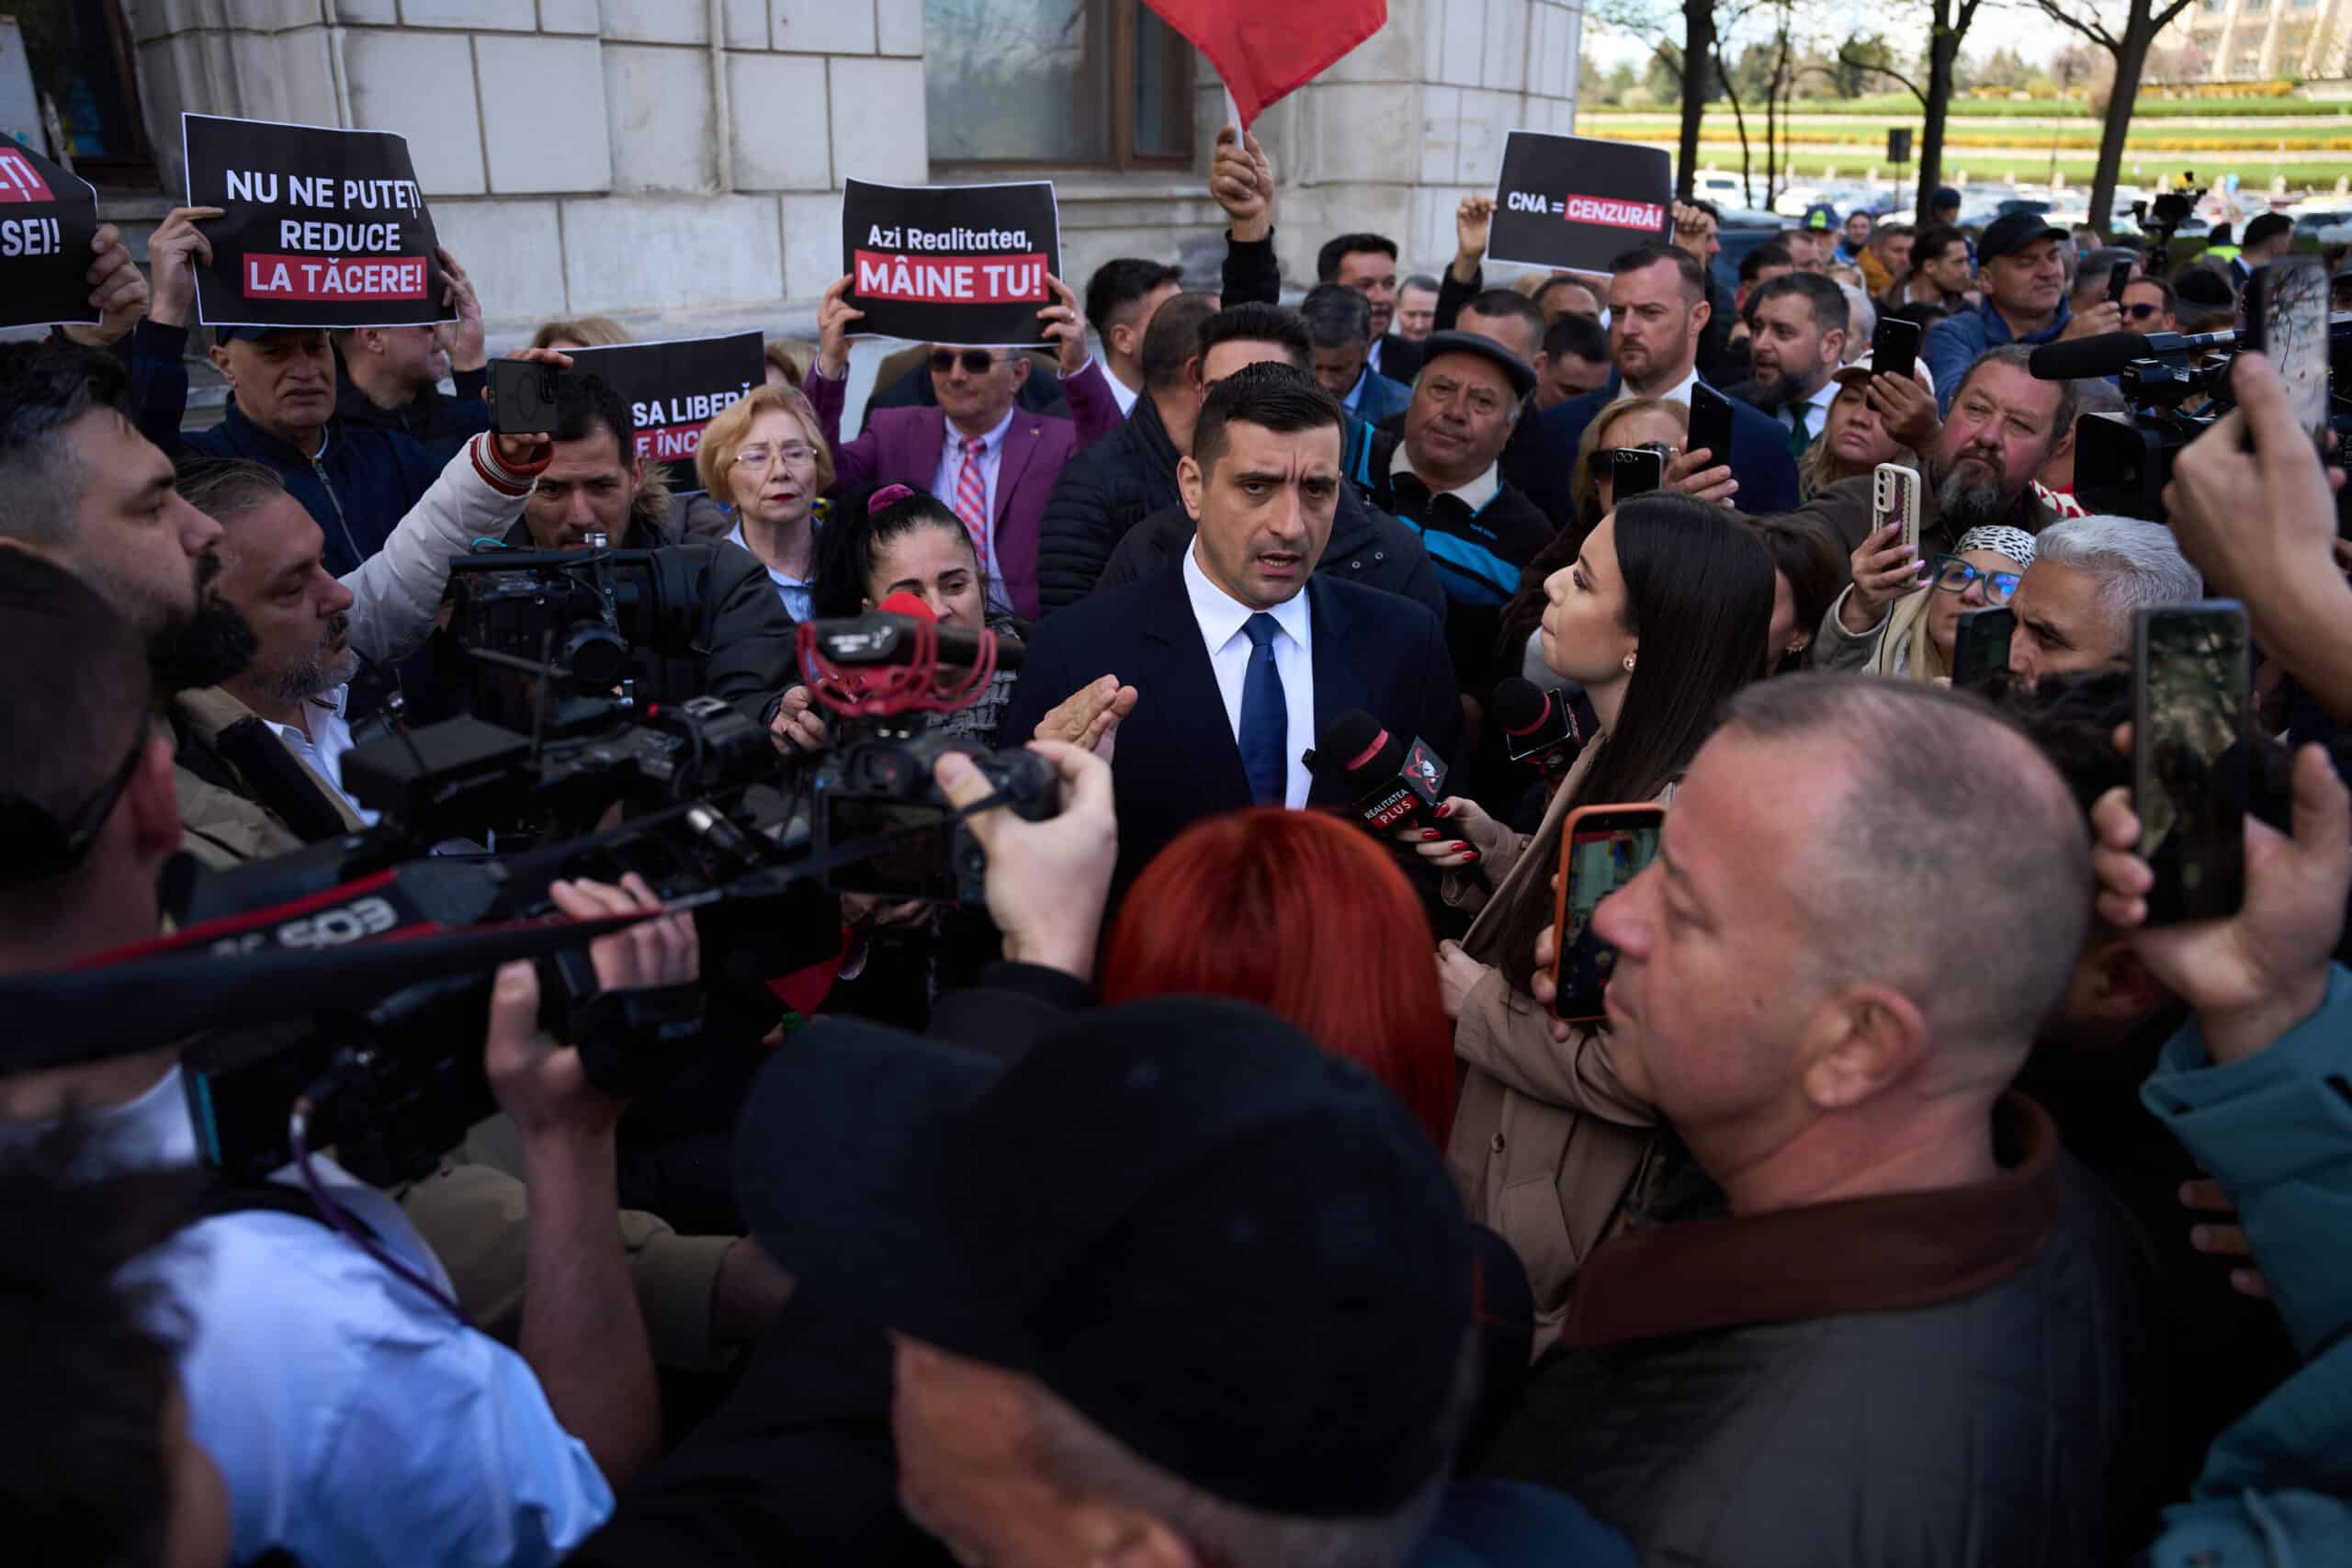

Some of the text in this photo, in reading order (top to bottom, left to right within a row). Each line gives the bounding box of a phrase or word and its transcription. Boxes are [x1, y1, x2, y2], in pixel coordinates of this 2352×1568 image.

[226, 169, 279, 203] NU
[289, 175, 334, 209] NE
[1508, 191, 1547, 214] CNA
[1567, 197, 1664, 229] CENZURĂ!
[279, 219, 401, 252] REDUCE
[867, 224, 1033, 252] Azi Realitatea,
[249, 257, 423, 294] LA TĂCERE!
[860, 254, 1041, 299] MÂINE TU!
[656, 428, 707, 457] ÎNC
[1364, 789, 1410, 820] REALITATEA
[1380, 800, 1411, 824] PLUS
